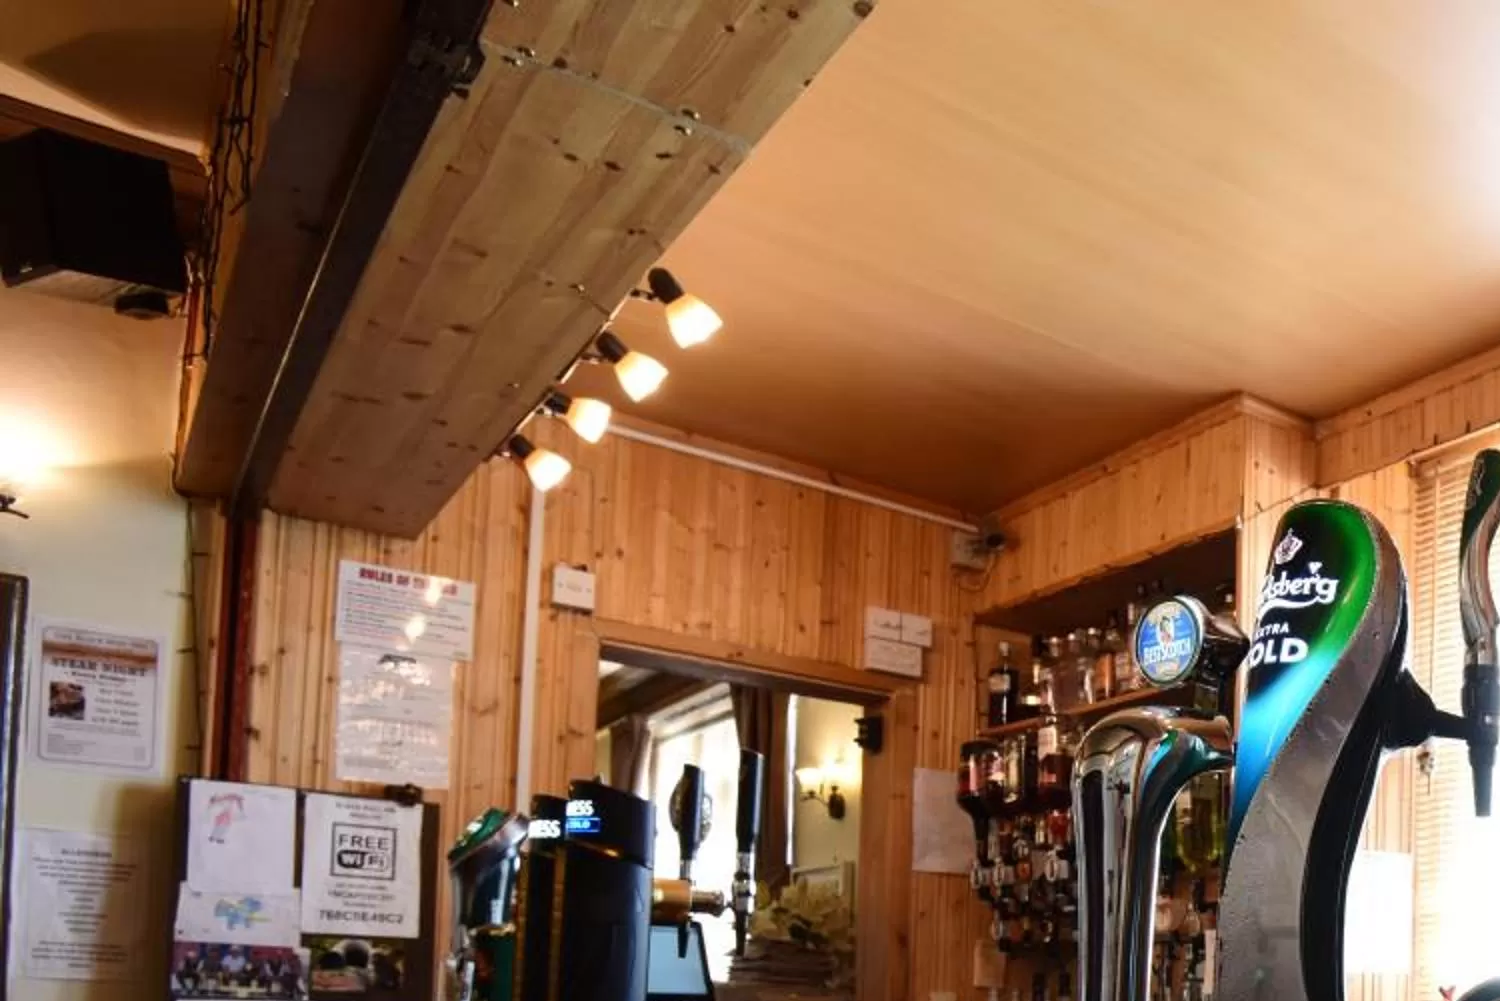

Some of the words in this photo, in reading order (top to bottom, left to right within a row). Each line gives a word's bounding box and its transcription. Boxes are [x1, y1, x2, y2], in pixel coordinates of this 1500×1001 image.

[1263, 570, 1340, 604] lsberg
[1249, 637, 1309, 668] OLD
[339, 833, 389, 851] FREE
